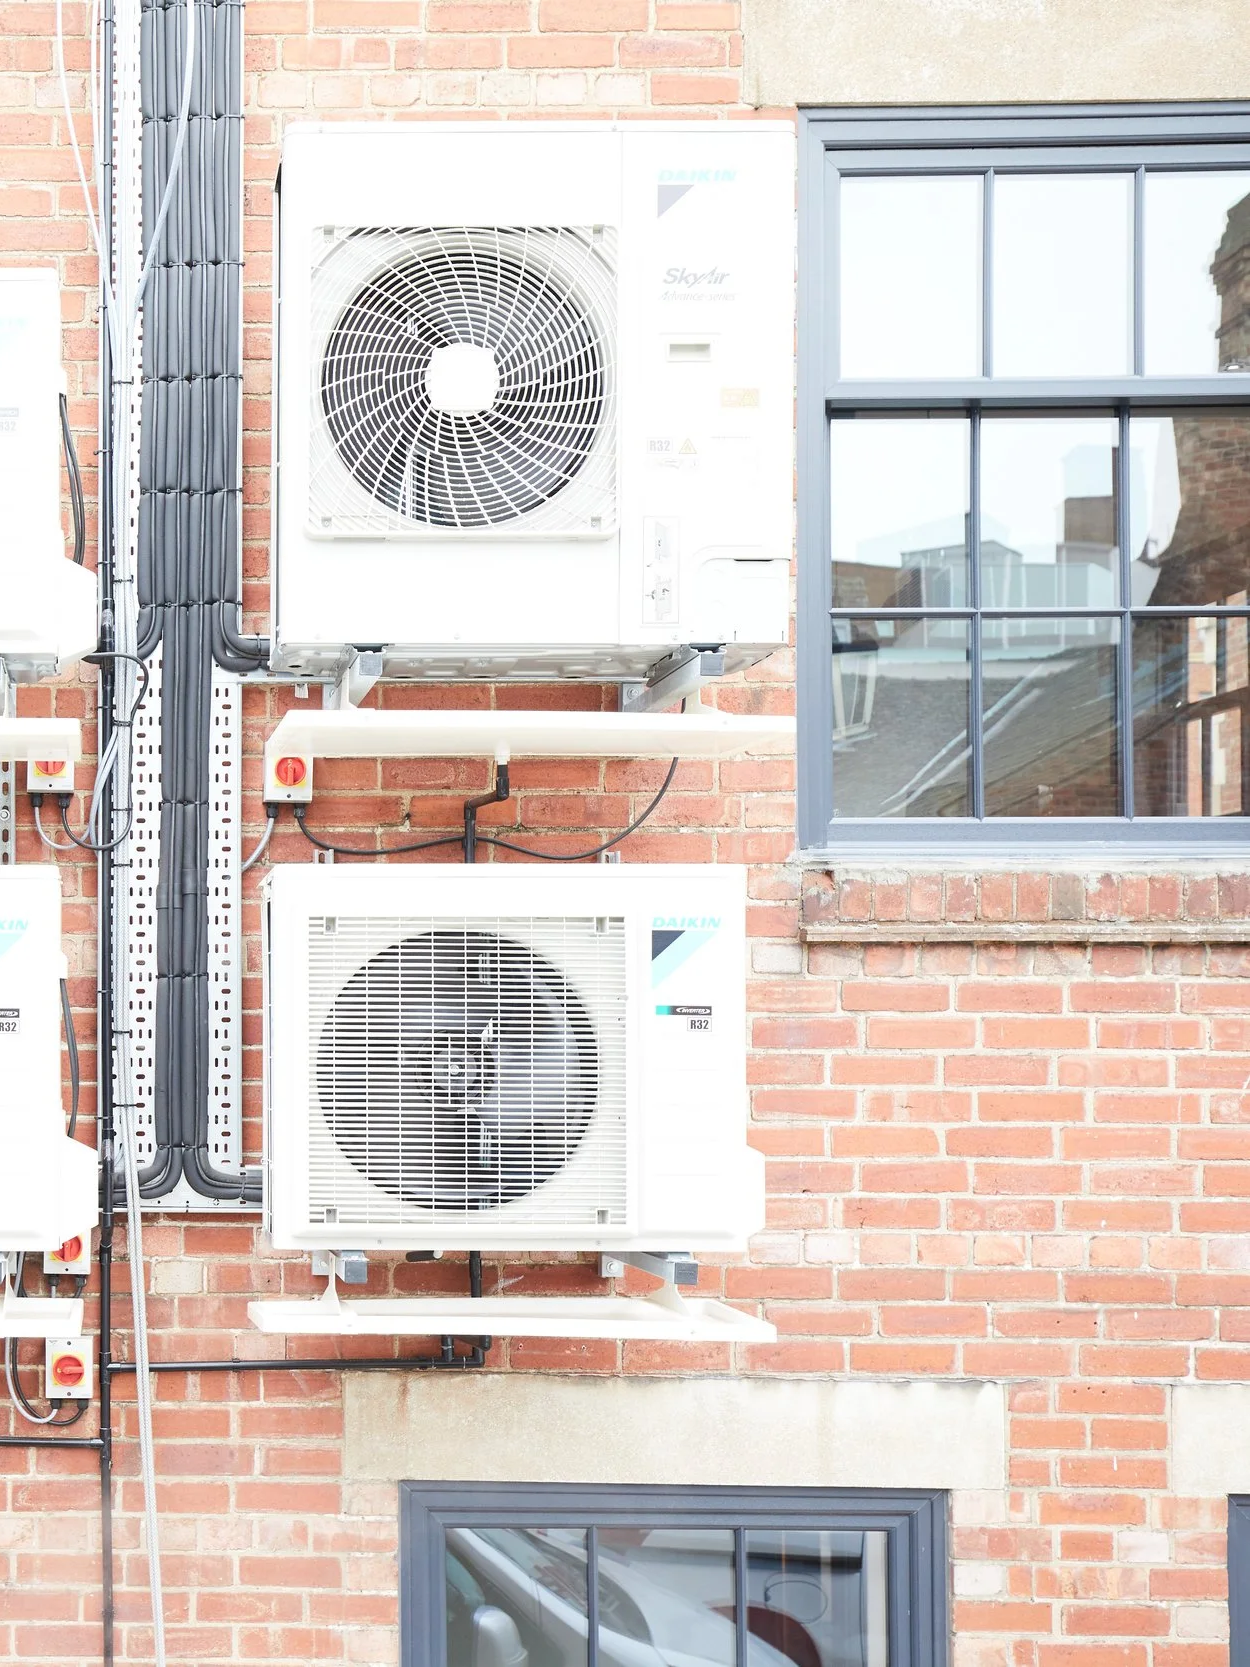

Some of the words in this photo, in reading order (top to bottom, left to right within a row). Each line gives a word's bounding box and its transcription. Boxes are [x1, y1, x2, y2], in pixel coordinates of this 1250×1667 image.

[658, 169, 738, 182] DAIKIN
[649, 440, 671, 452] R32
[652, 917, 722, 929] DAIKIN
[0, 1022, 17, 1032] R32
[690, 1020, 709, 1030] R32
